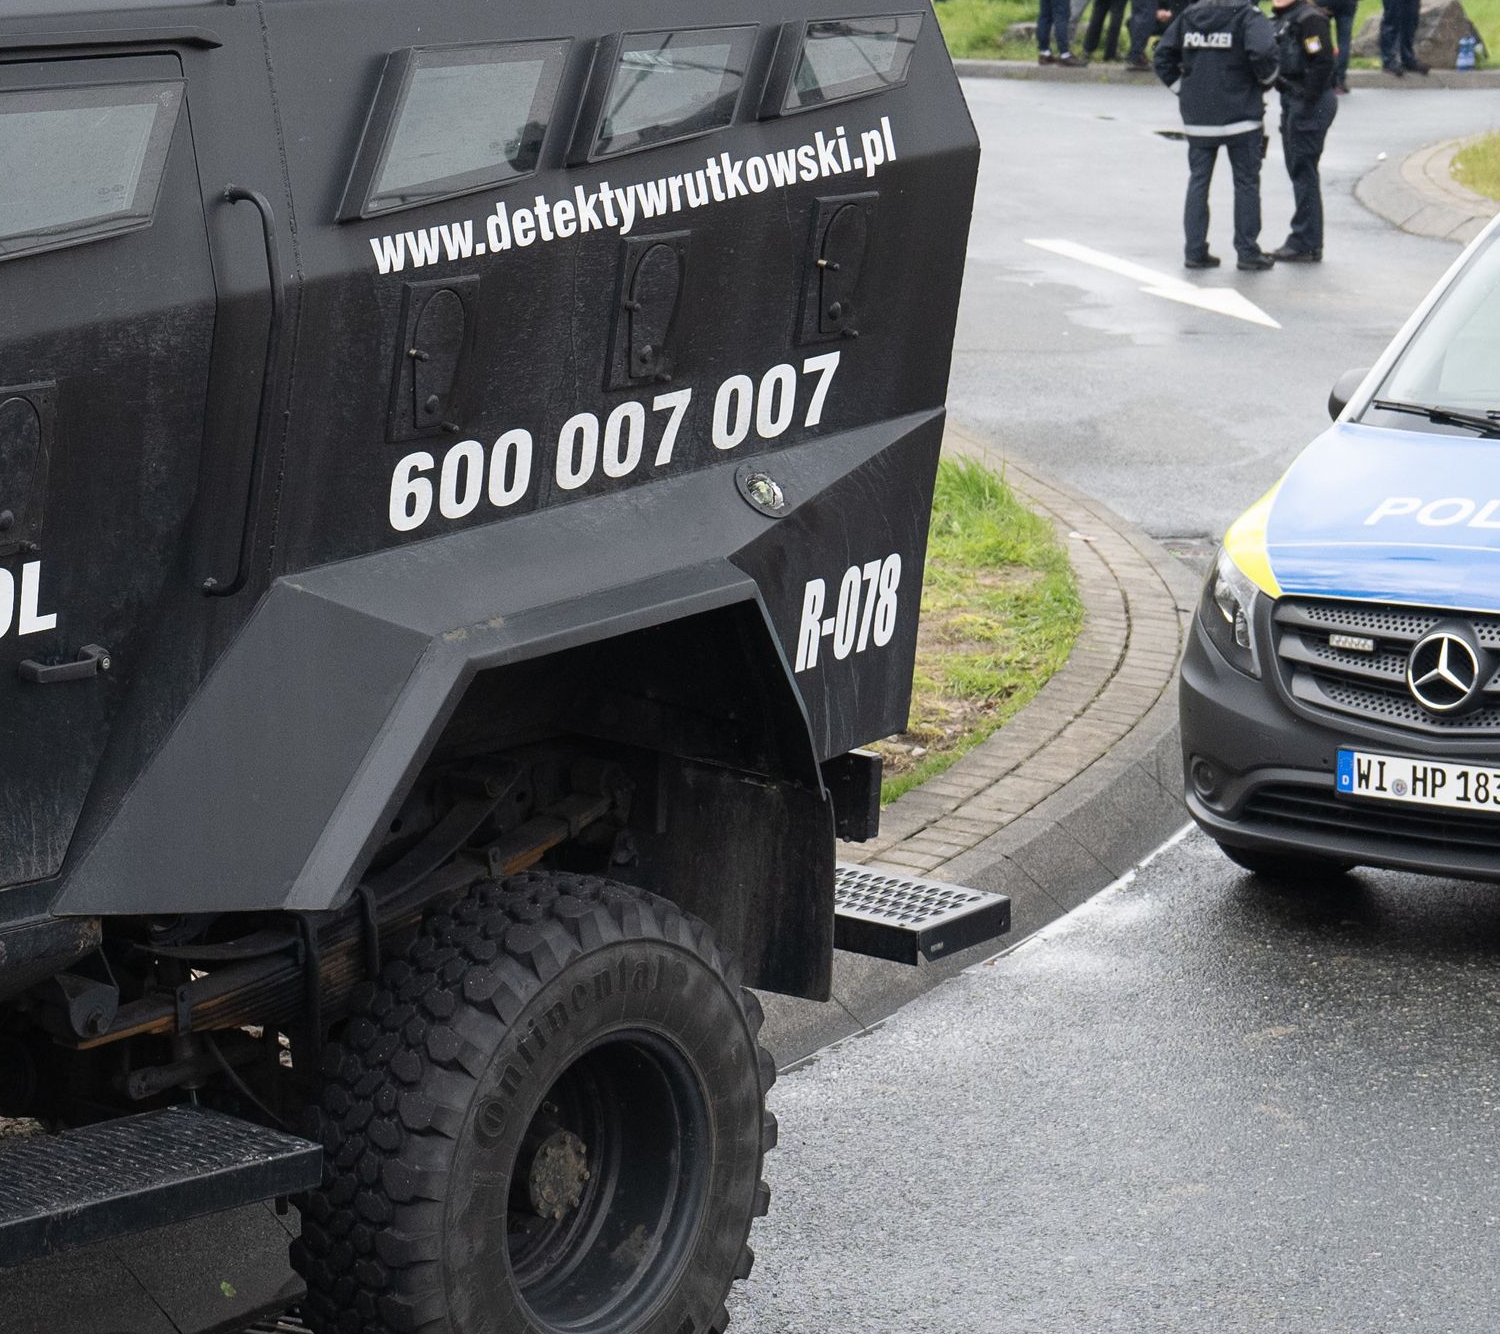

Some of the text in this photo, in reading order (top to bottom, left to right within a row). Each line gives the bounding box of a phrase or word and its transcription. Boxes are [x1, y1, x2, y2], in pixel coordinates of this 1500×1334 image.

[1183, 32, 1233, 48] POLIZEI
[369, 116, 897, 275] www.detektywrutkowski.pl
[389, 350, 841, 532] 600 007 007
[794, 553, 902, 674] R-078
[1356, 757, 1388, 792] WI
[1411, 764, 1446, 798] HP
